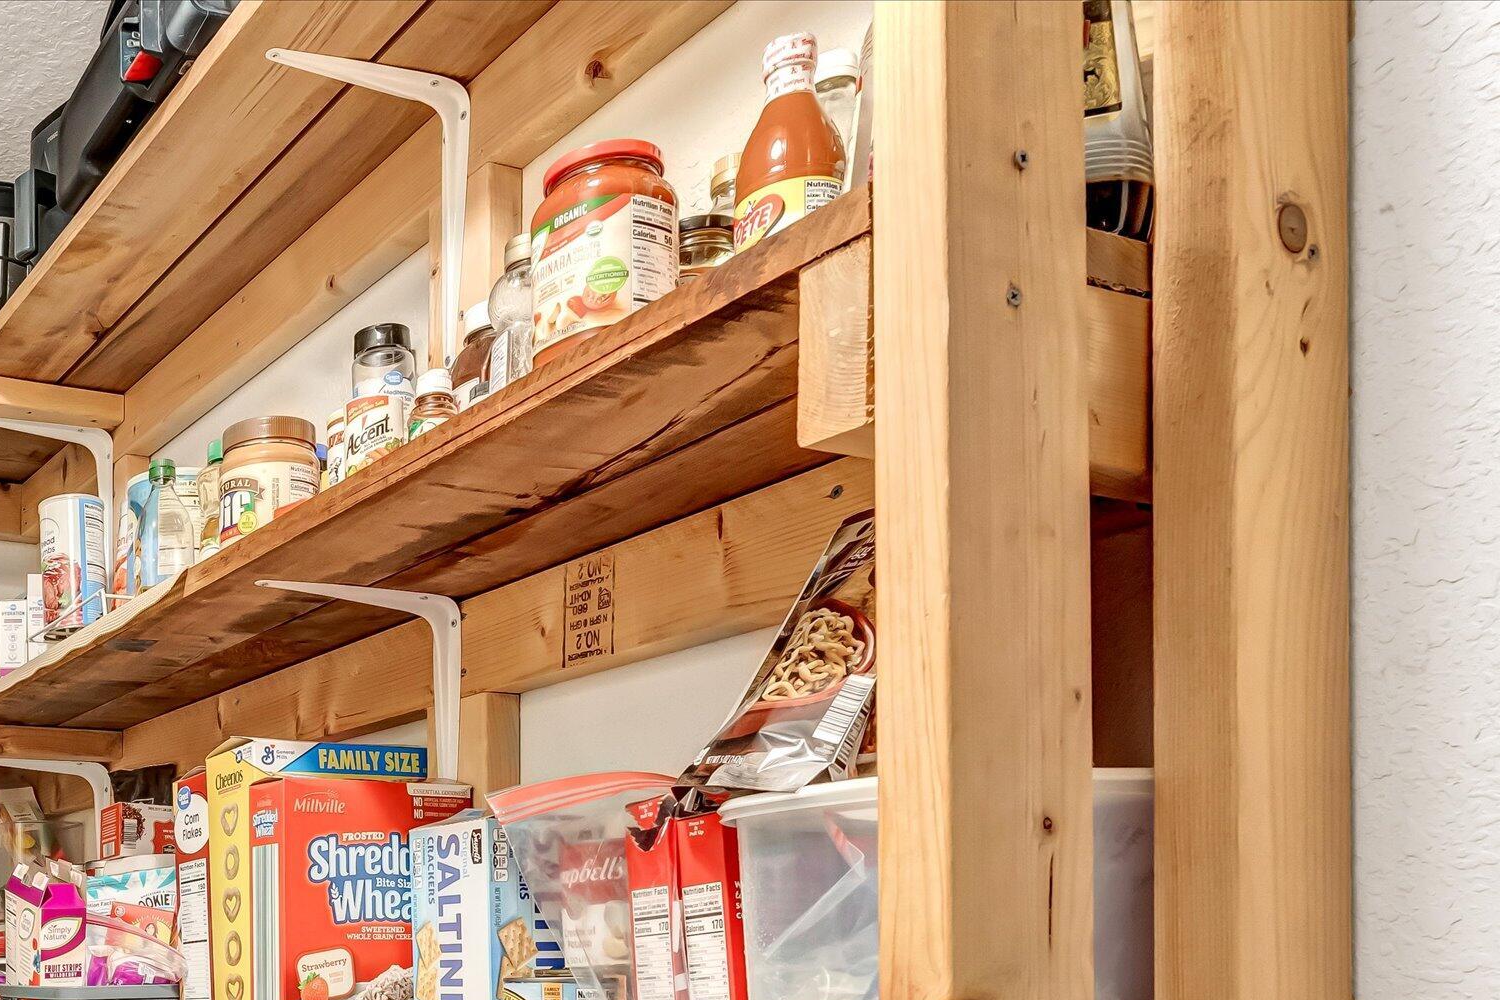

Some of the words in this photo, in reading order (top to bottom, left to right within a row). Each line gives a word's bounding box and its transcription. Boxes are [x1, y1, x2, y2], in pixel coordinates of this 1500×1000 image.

[632, 197, 658, 211] Nutrition
[659, 203, 673, 215] Facts
[554, 203, 588, 229] ORGANIC
[632, 228, 657, 241] Calories
[664, 235, 673, 246] 50
[220, 479, 251, 494] TURAL
[575, 633, 583, 650] 2
[318, 748, 380, 771] FAMILY
[385, 750, 420, 774] SIZE
[215, 769, 244, 791] Cheerios
[293, 794, 346, 814] Millville
[413, 797, 423, 807] NO
[184, 813, 200, 826] Corn
[413, 809, 424, 820] NO
[182, 827, 203, 841] Flakes
[342, 831, 385, 842] FROSTED
[308, 834, 412, 882] Shredd
[427, 836, 436, 905] CRACKERS
[376, 877, 395, 888] Bite
[397, 878, 412, 888] Siz
[683, 886, 704, 896] Nutrition
[705, 883, 721, 892] Facts
[632, 889, 652, 899] Nutrition
[653, 887, 668, 896] Facts
[331, 879, 412, 923] Whea
[47, 925, 72, 935] Simply
[361, 926, 405, 934] SWEETENED
[634, 925, 652, 934] Calories
[658, 921, 669, 931] 170
[685, 924, 705, 932] Calories
[711, 918, 723, 930] 170
[346, 933, 370, 941] WHOLE
[372, 933, 394, 941] GRAIN
[44, 964, 61, 972] FRUIT
[61, 963, 82, 971] STRIPS
[301, 957, 347, 973] Strawberry
